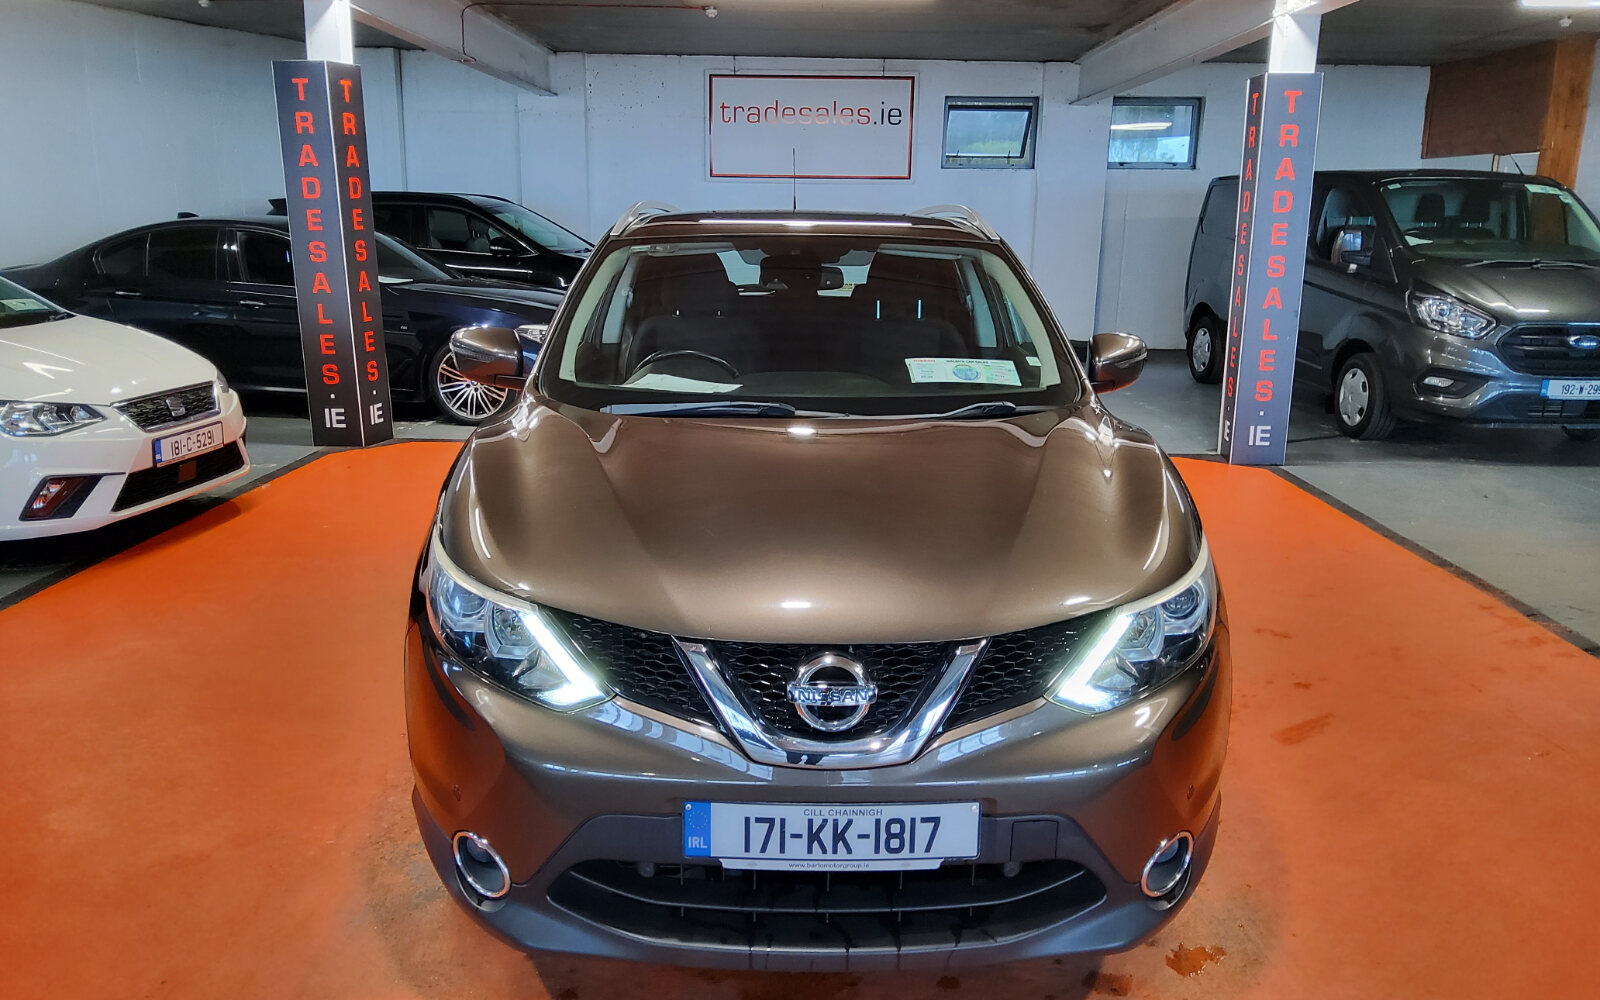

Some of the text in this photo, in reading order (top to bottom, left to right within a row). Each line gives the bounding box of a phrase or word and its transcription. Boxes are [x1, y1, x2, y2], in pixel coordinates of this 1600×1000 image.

[720, 99, 902, 126] tradesales.ie
[170, 429, 215, 457] 181-C-5291
[798, 687, 869, 703] NISSAN
[803, 808, 883, 817] CILL CHAINNIGH
[687, 836, 708, 849] IRL
[743, 816, 941, 855] 171-KK-1817
